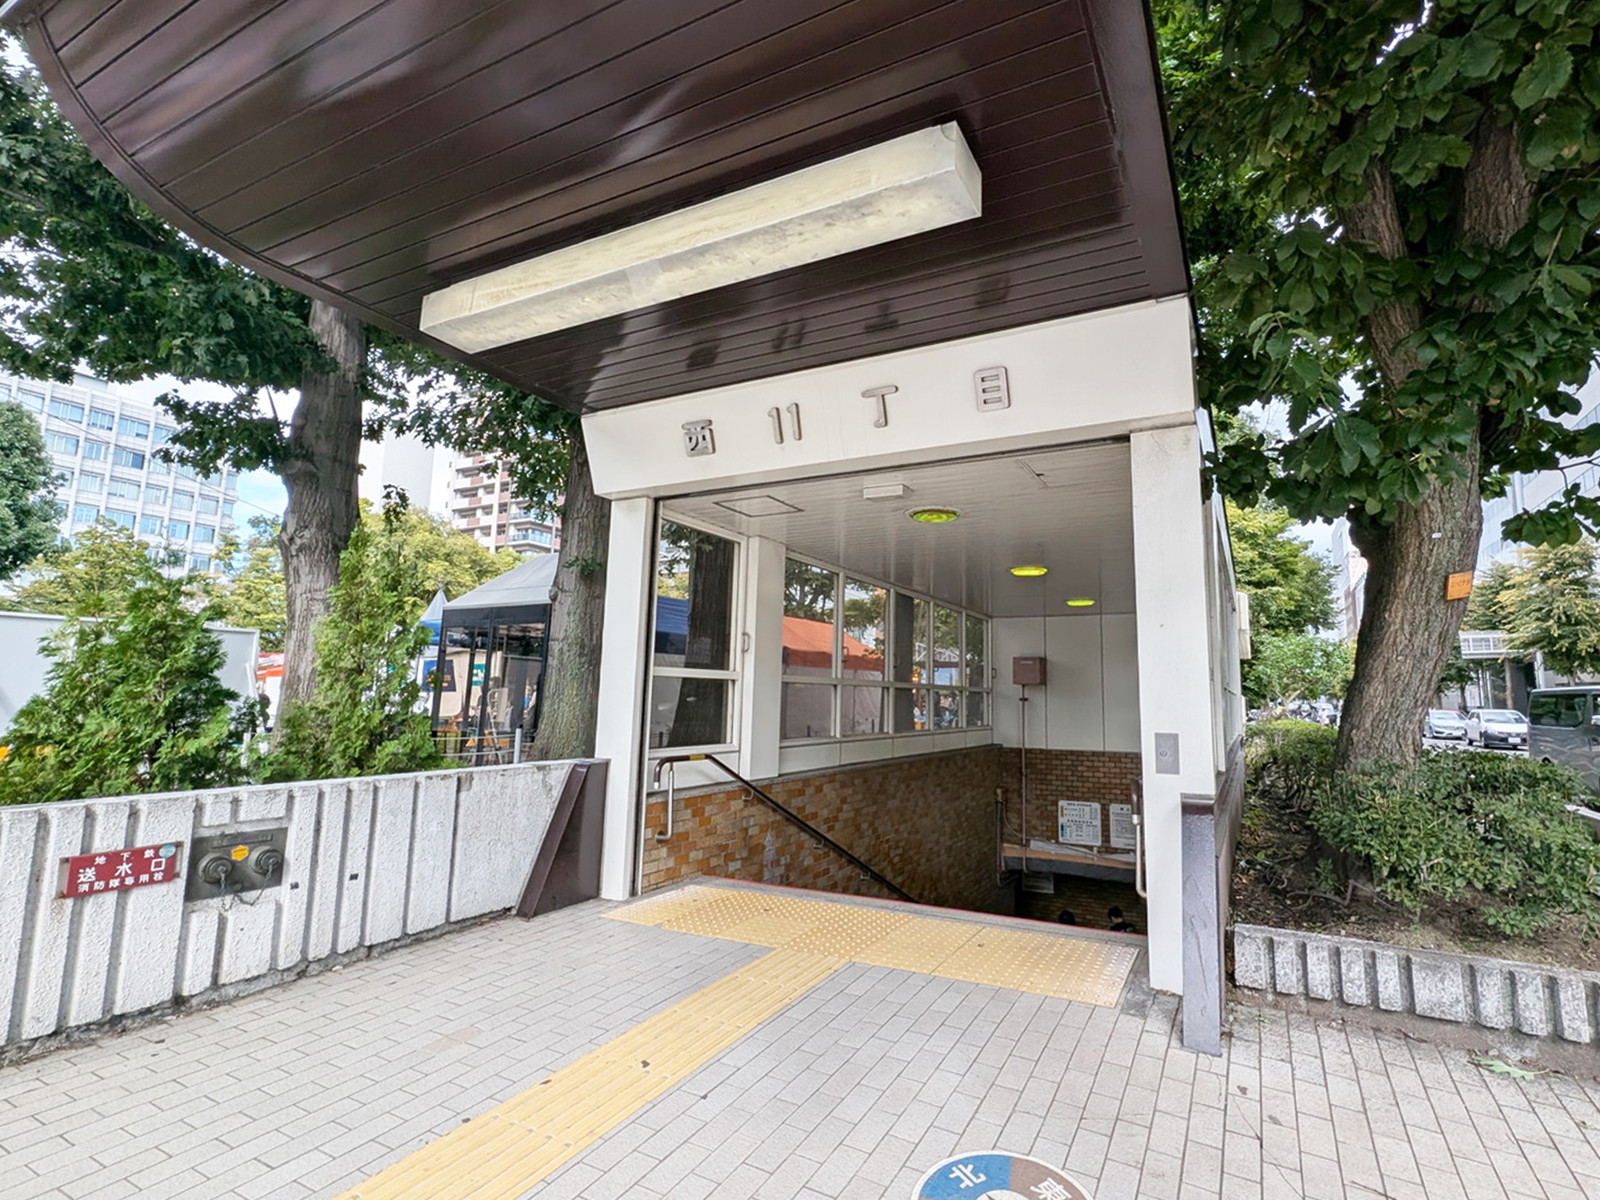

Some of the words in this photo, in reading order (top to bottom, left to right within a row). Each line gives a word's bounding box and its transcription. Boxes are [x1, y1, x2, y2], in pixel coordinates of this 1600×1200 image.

[681, 365, 1012, 457] 西11丁目
[94, 849, 155, 865] 地下鉄
[77, 858, 166, 883] 送水口
[949, 1163, 987, 1189] 北
[1030, 1177, 1073, 1200] 東
